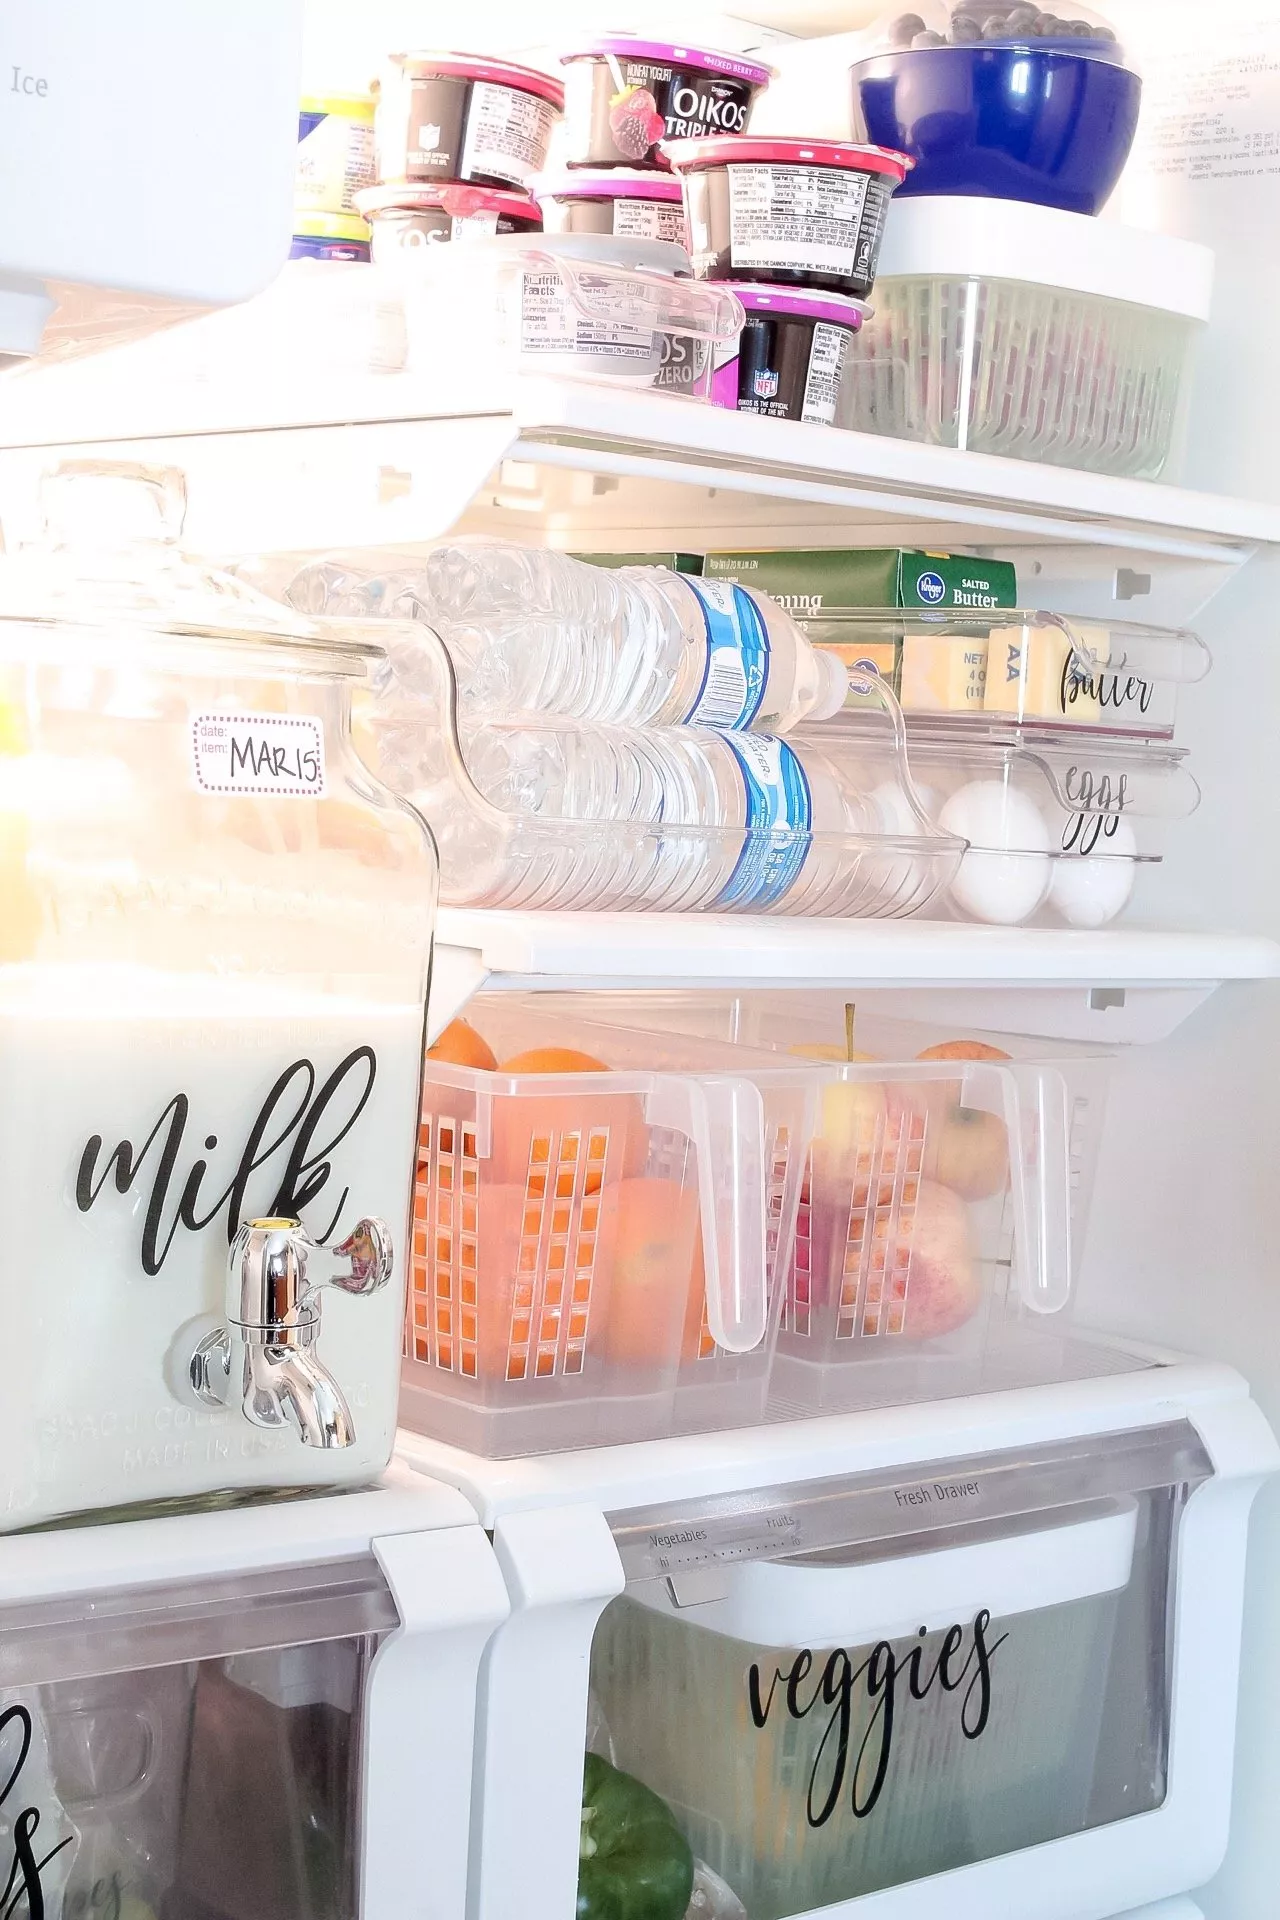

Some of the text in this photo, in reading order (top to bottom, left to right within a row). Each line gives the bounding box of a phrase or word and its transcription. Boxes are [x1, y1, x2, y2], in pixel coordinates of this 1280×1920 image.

[11, 66, 48, 97] Ice
[650, 66, 672, 82] YOGURT
[673, 88, 747, 131] OIKOS
[659, 365, 692, 384] ZERO
[757, 380, 774, 393] NFL
[769, 402, 789, 410] OFFICIAL
[777, 409, 786, 417] NFL
[921, 577, 942, 598] Kroger
[962, 578, 989, 590] SALTED
[953, 588, 998, 608] Butter
[964, 652, 984, 664] NET
[969, 671, 976, 680] 4
[1061, 647, 1154, 713] Butter
[200, 725, 228, 737] date:
[201, 743, 228, 754] item:
[231, 737, 296, 777] MAR
[1062, 766, 1134, 855] eggs
[775, 853, 785, 864] CA
[894, 1480, 981, 1507] Fresh Drawer
[767, 1514, 795, 1529] Fruits
[650, 1528, 708, 1549] Vegetables
[659, 1556, 670, 1569] hi
[748, 1608, 1010, 1828] veggies
